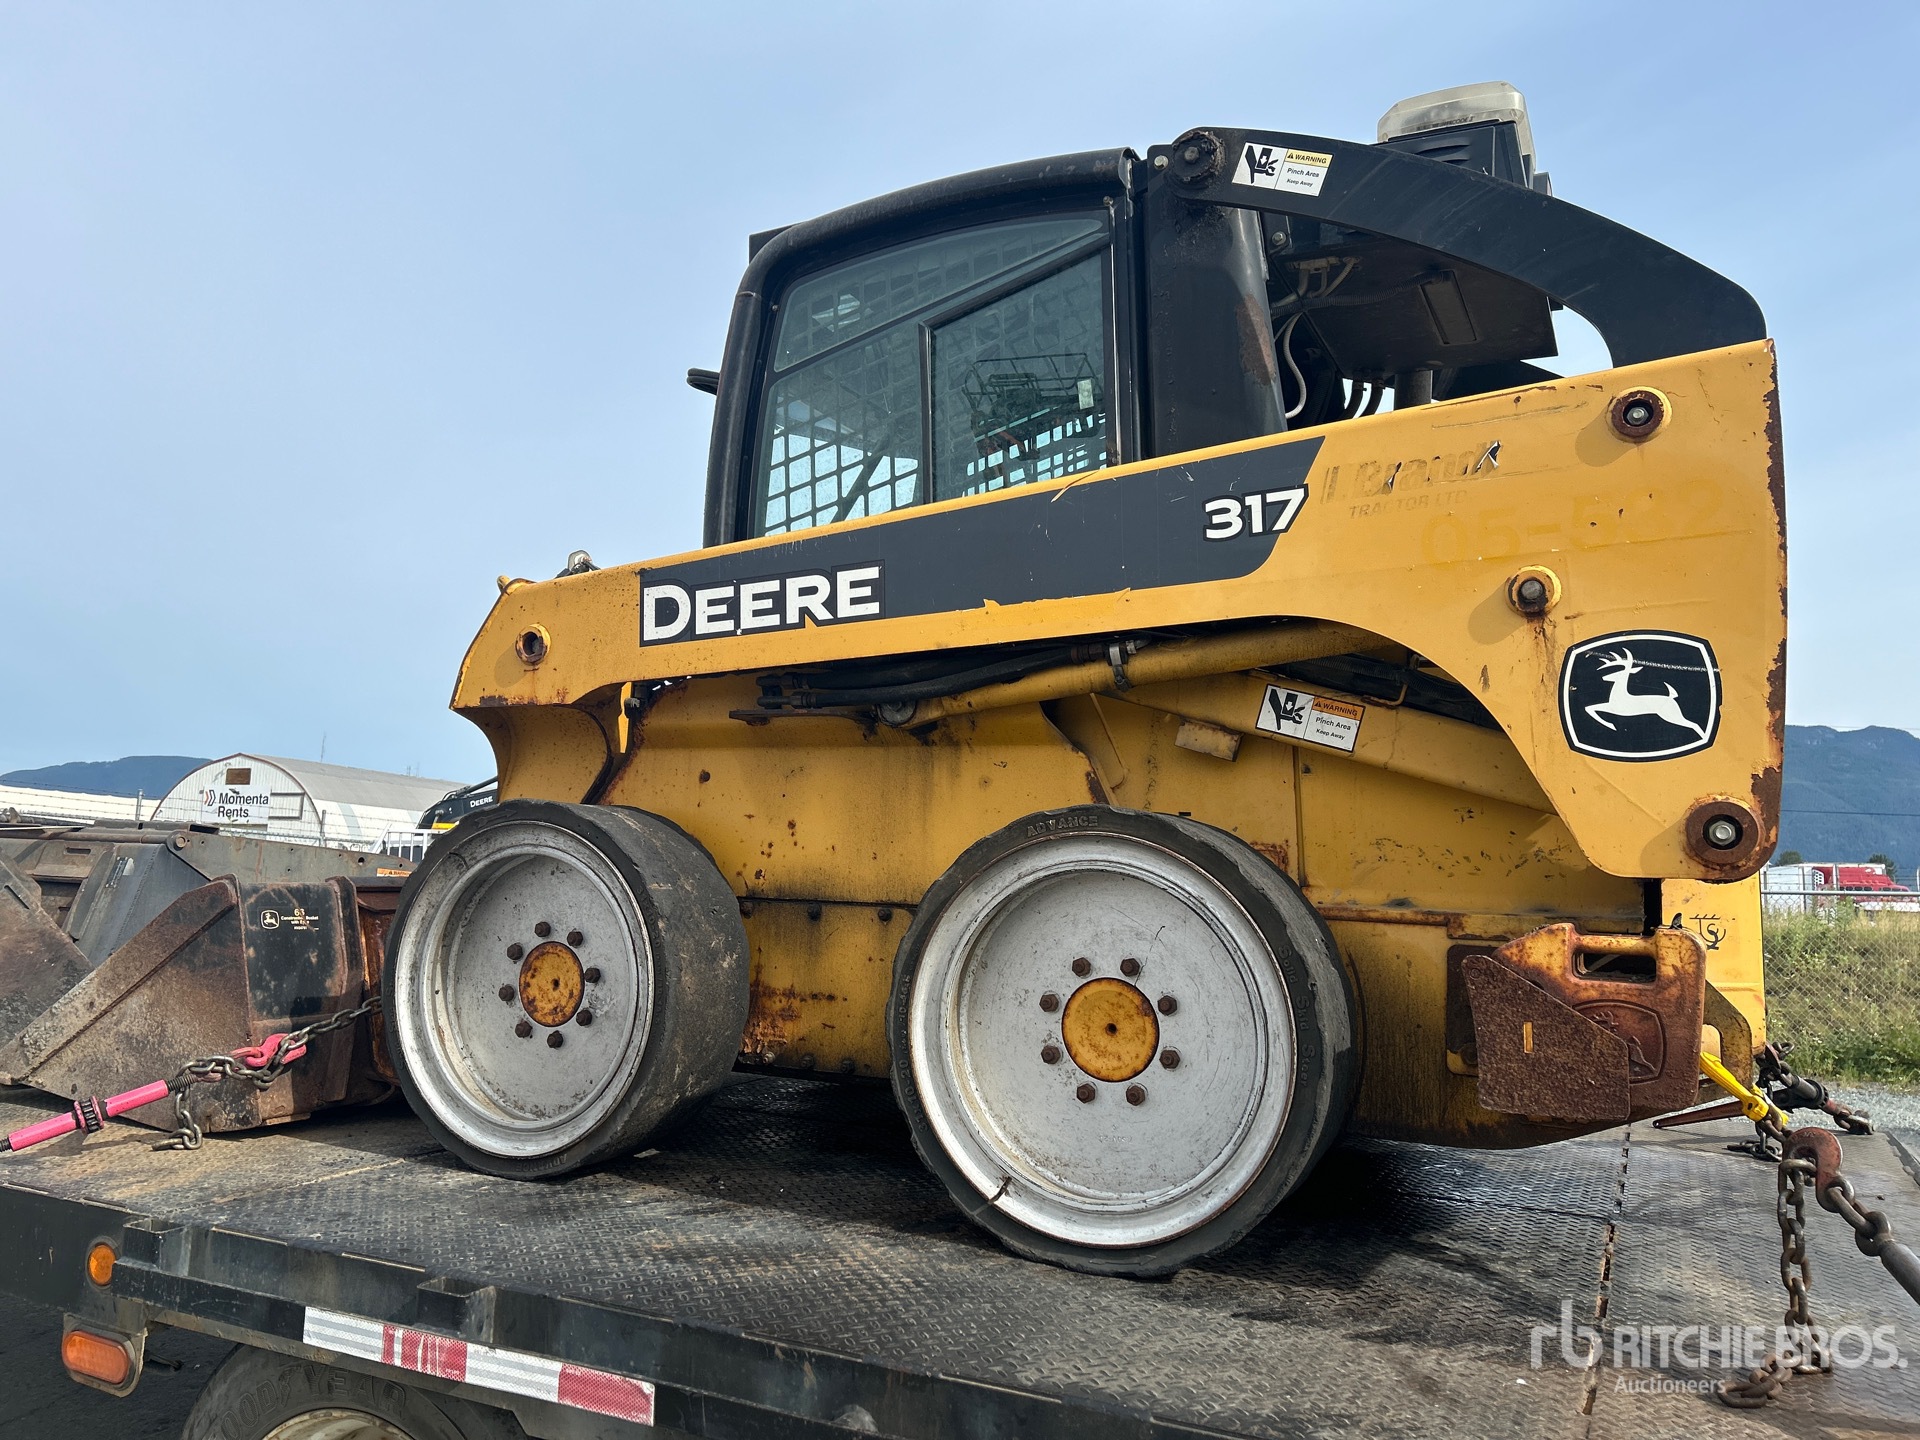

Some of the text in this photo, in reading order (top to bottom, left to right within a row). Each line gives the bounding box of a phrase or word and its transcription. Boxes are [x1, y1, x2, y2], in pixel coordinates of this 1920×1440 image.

[1295, 153, 1327, 164] WARNING
[1286, 167, 1320, 178] Pinch Area
[1286, 178, 1314, 188] Keep Away
[1204, 487, 1306, 540] 317
[643, 565, 881, 642] DEERE
[1322, 702, 1358, 717] WARNING
[1315, 716, 1352, 731] Pinch Area
[1315, 728, 1346, 741] Keep Away
[218, 792, 269, 805] Momenta
[469, 795, 494, 809] DEERE
[217, 805, 249, 818] Rents
[1026, 815, 1099, 838] ADVANCE
